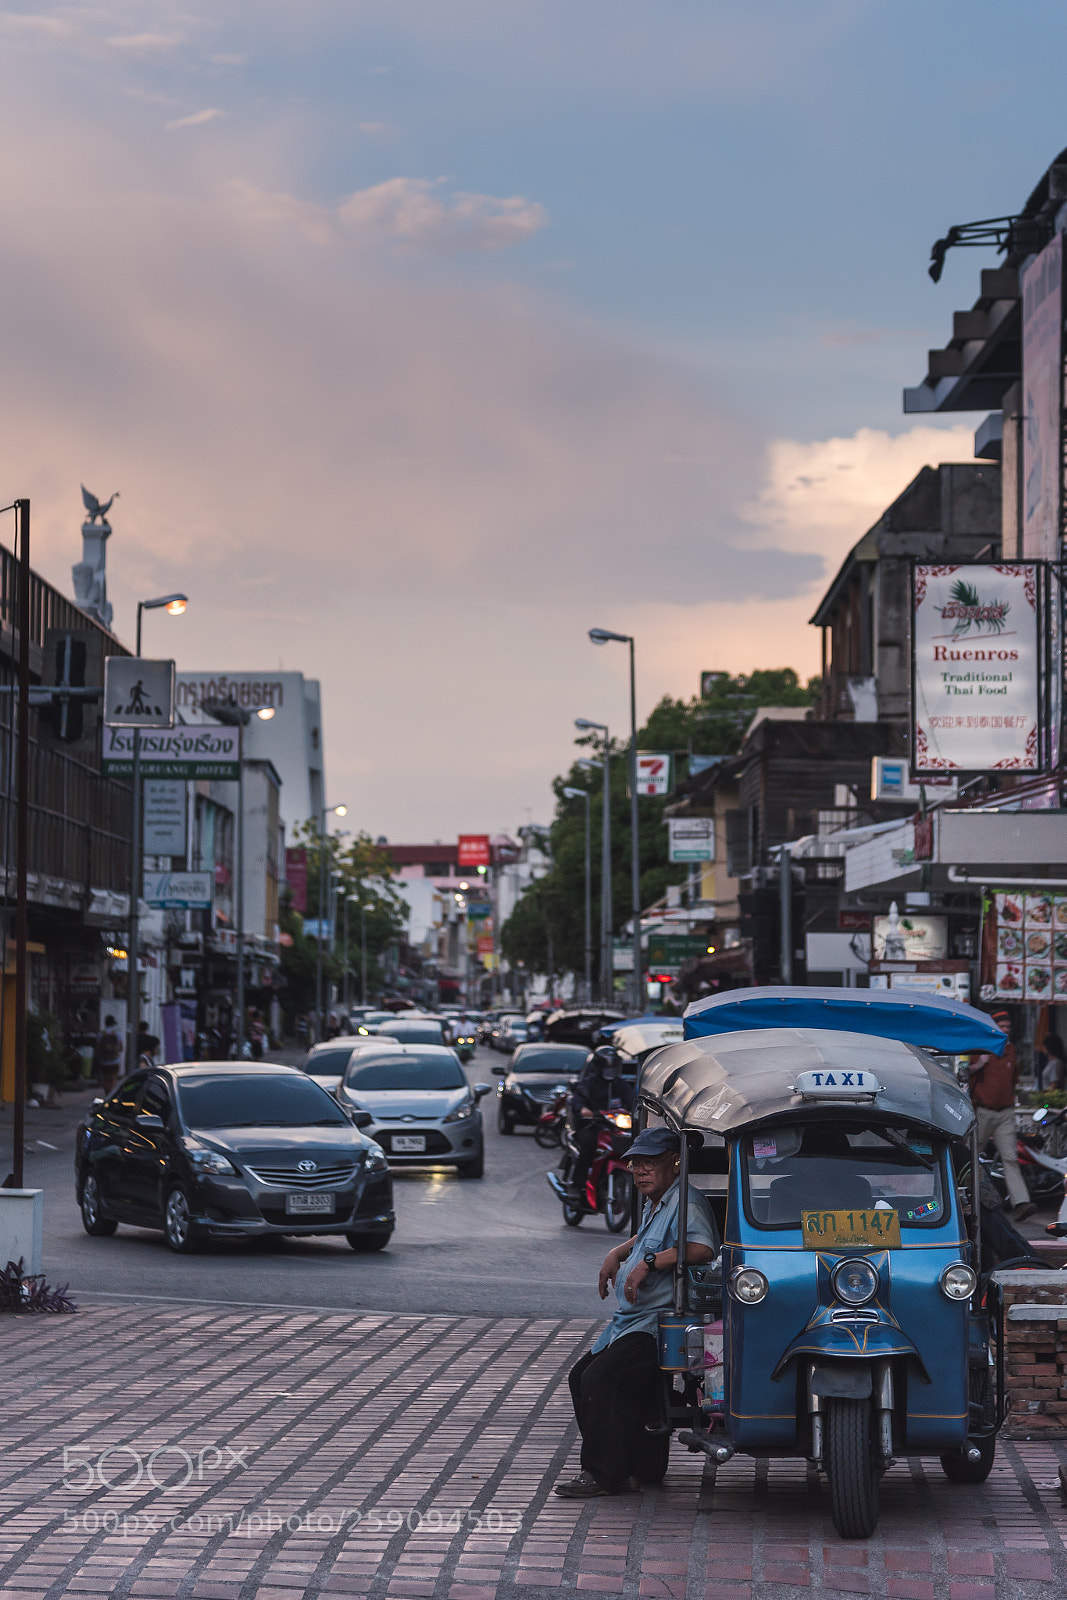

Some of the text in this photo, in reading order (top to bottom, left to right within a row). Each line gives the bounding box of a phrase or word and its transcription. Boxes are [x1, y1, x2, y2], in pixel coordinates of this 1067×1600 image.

[933, 645, 1019, 661] Ruenros
[941, 672, 1013, 682] Traditional
[945, 685, 1008, 695] Thai Food
[930, 715, 1028, 729] 欢迎来到泰国餐厅
[195, 764, 234, 775] HOTEL
[812, 1073, 865, 1086] TAXI
[806, 1212, 894, 1232] สก 1147
